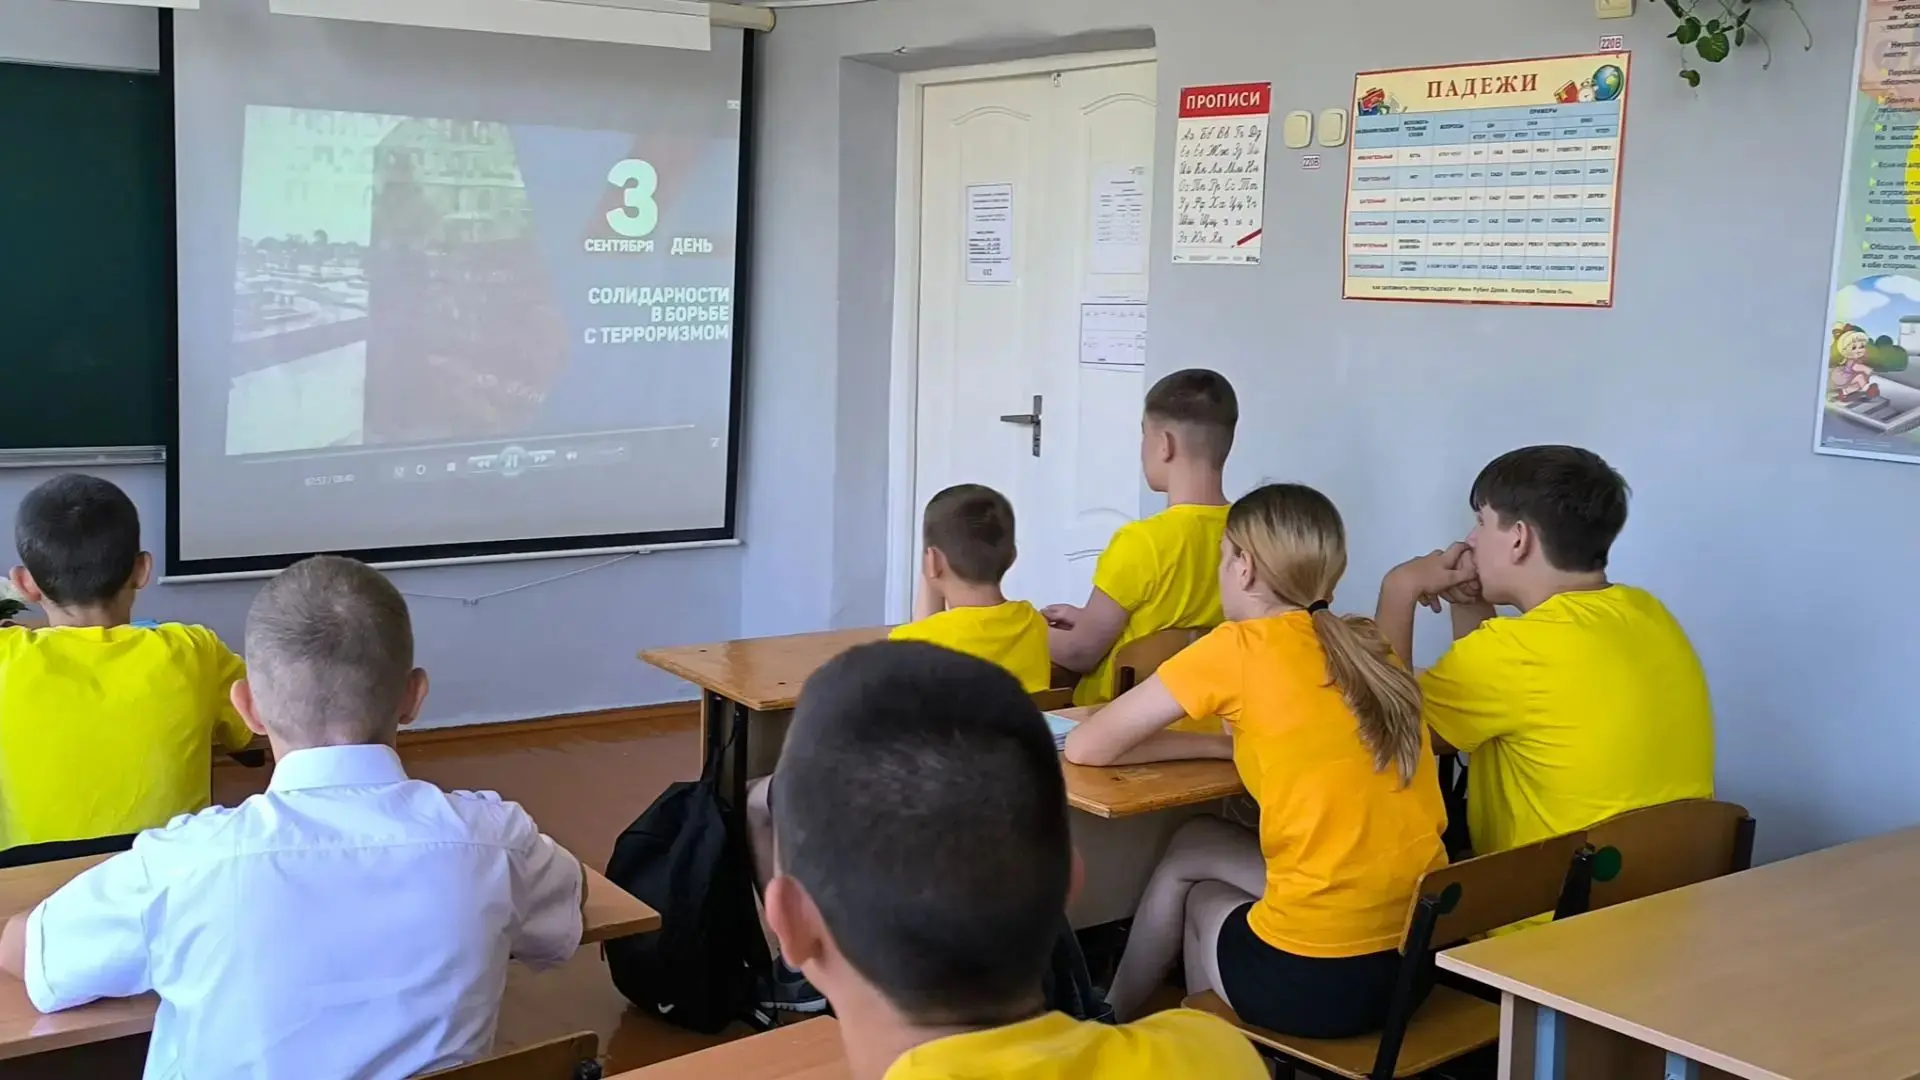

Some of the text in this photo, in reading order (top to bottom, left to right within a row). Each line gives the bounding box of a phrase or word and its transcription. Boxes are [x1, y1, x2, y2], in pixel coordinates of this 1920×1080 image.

[1426, 73, 1538, 100] ПАДЕЖИ
[1186, 91, 1260, 110] ПРОПИСИ
[606, 158, 658, 237] 3
[584, 237, 714, 255] СЕНТЯБРЯ ДЕНЬ
[588, 287, 730, 306] СОЛИДАРНОСТИ
[651, 306, 729, 322] В БОРЬБЕ
[584, 325, 729, 344] С ТЕРРОРИЗМОМ
